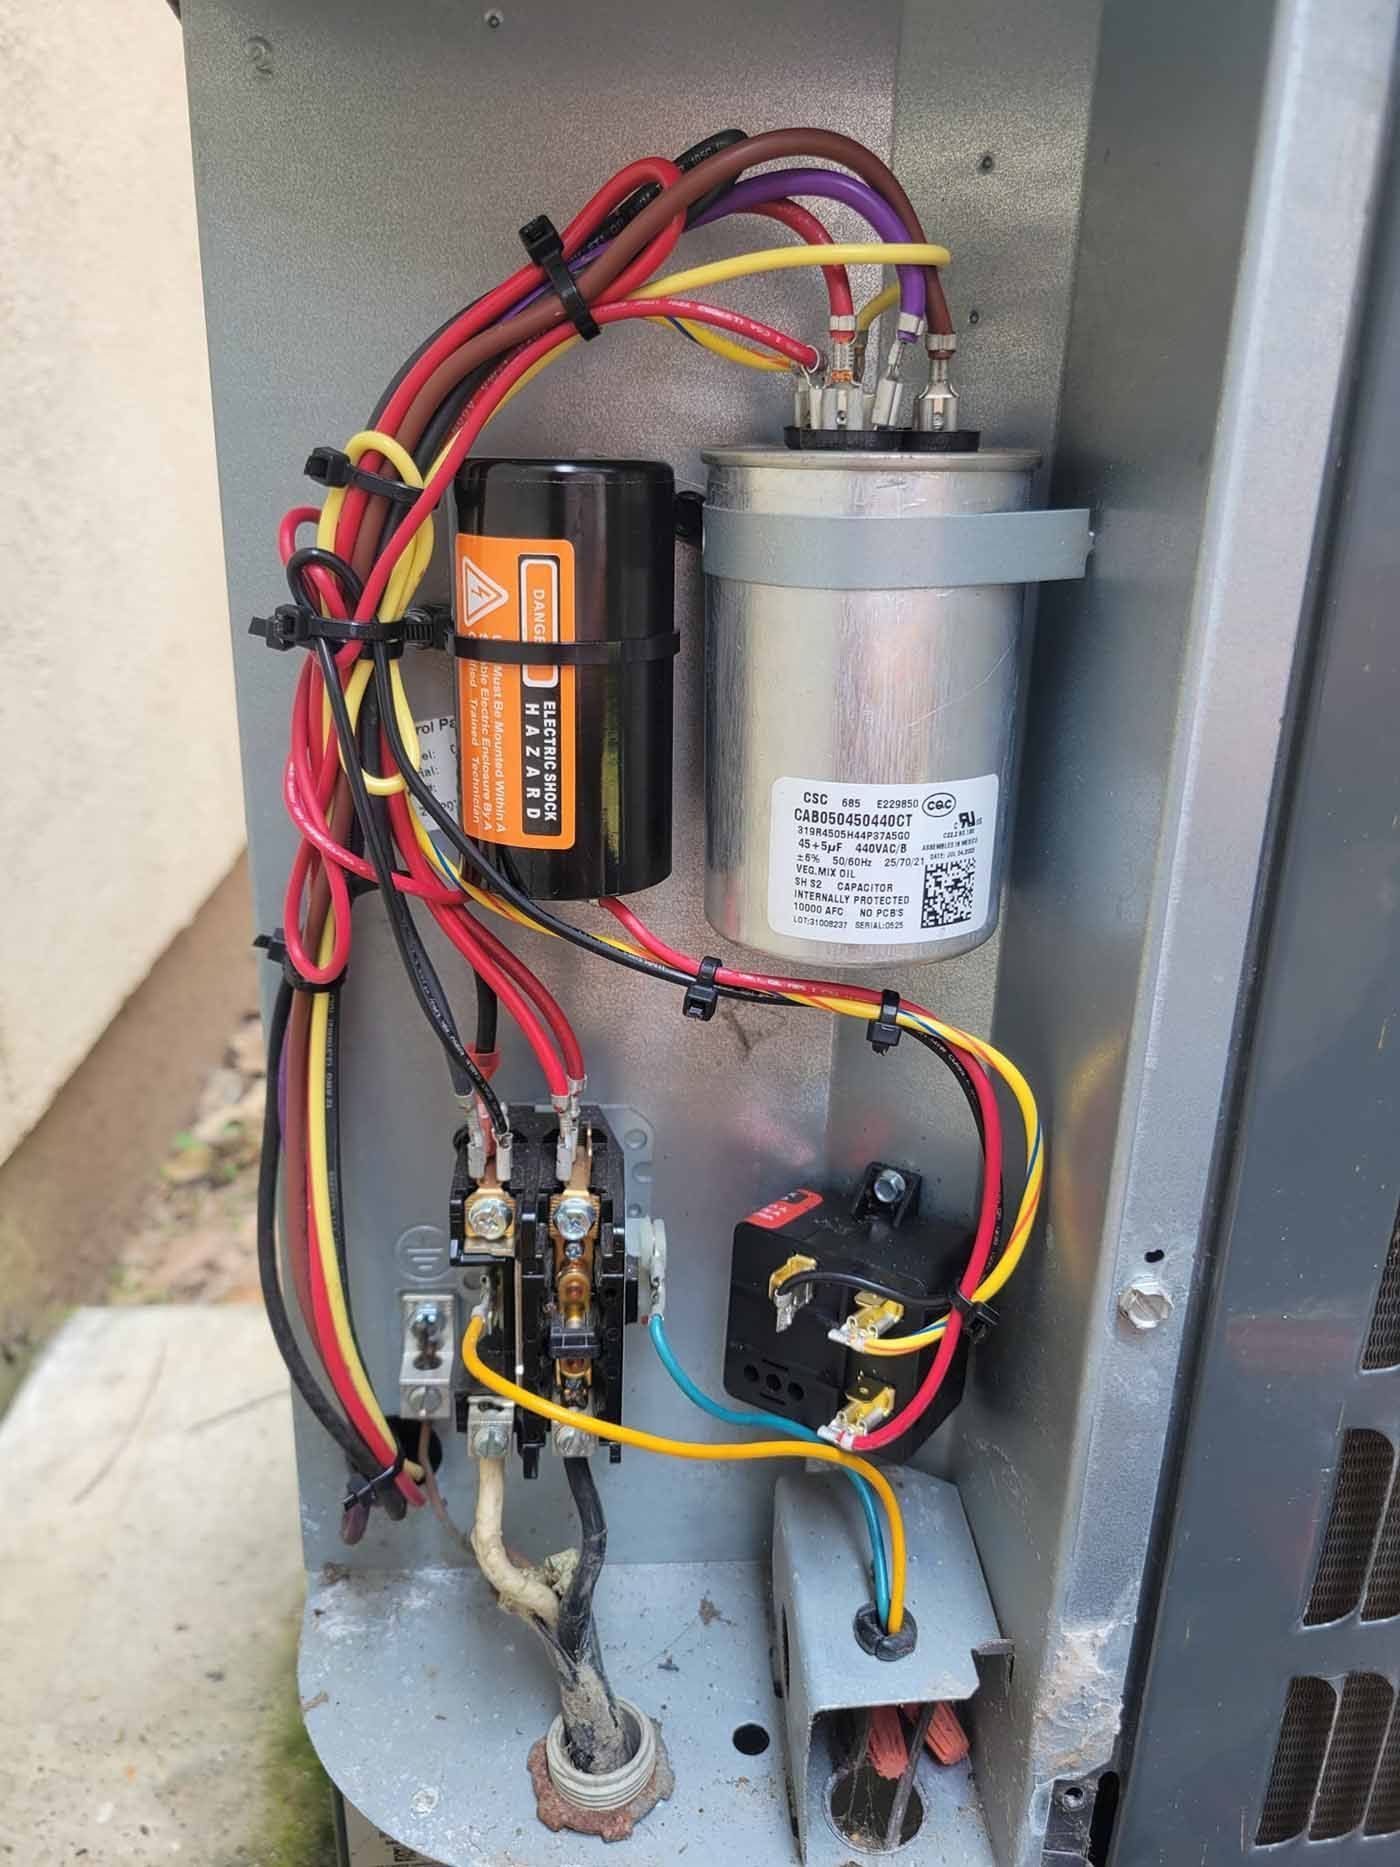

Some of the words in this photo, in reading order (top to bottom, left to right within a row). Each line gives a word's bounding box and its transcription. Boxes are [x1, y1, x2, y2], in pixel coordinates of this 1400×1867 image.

[531, 589, 545, 644] DANGE
[492, 664, 503, 698] Must
[481, 688, 490, 736] Electric
[493, 701, 504, 719] Be
[469, 699, 480, 746] Trained
[543, 701, 557, 770] ELECTRIC
[494, 722, 505, 778] Mounted
[481, 739, 491, 801] Enclosure
[525, 703, 541, 819] HAZARD
[471, 757, 480, 824] Technician
[543, 774, 557, 821] SHOCK
[803, 791, 828, 805] CSC
[842, 798, 861, 808] 685
[877, 799, 919, 809] E229850
[495, 781, 505, 821] Within
[483, 802, 493, 820] By
[794, 808, 912, 827] CAB050450440CT
[483, 821, 493, 831] A
[497, 823, 507, 833] A
[855, 843, 907, 854] 440VAC/B
[796, 863, 836, 877] VEG.MIX
[839, 869, 856, 878] OIL
[832, 856, 872, 867] 50/60Hz
[884, 857, 925, 868] 25/70/21
[794, 877, 807, 887] SH
[810, 879, 822, 889] S2
[837, 881, 893, 892] CAPACITOR
[794, 889, 850, 904] INTERNALLY
[854, 895, 910, 905] PROTECTED
[793, 902, 822, 914] 10000
[825, 906, 844, 916] AFC
[860, 908, 872, 918] NO
[876, 908, 904, 918] PCB'S
